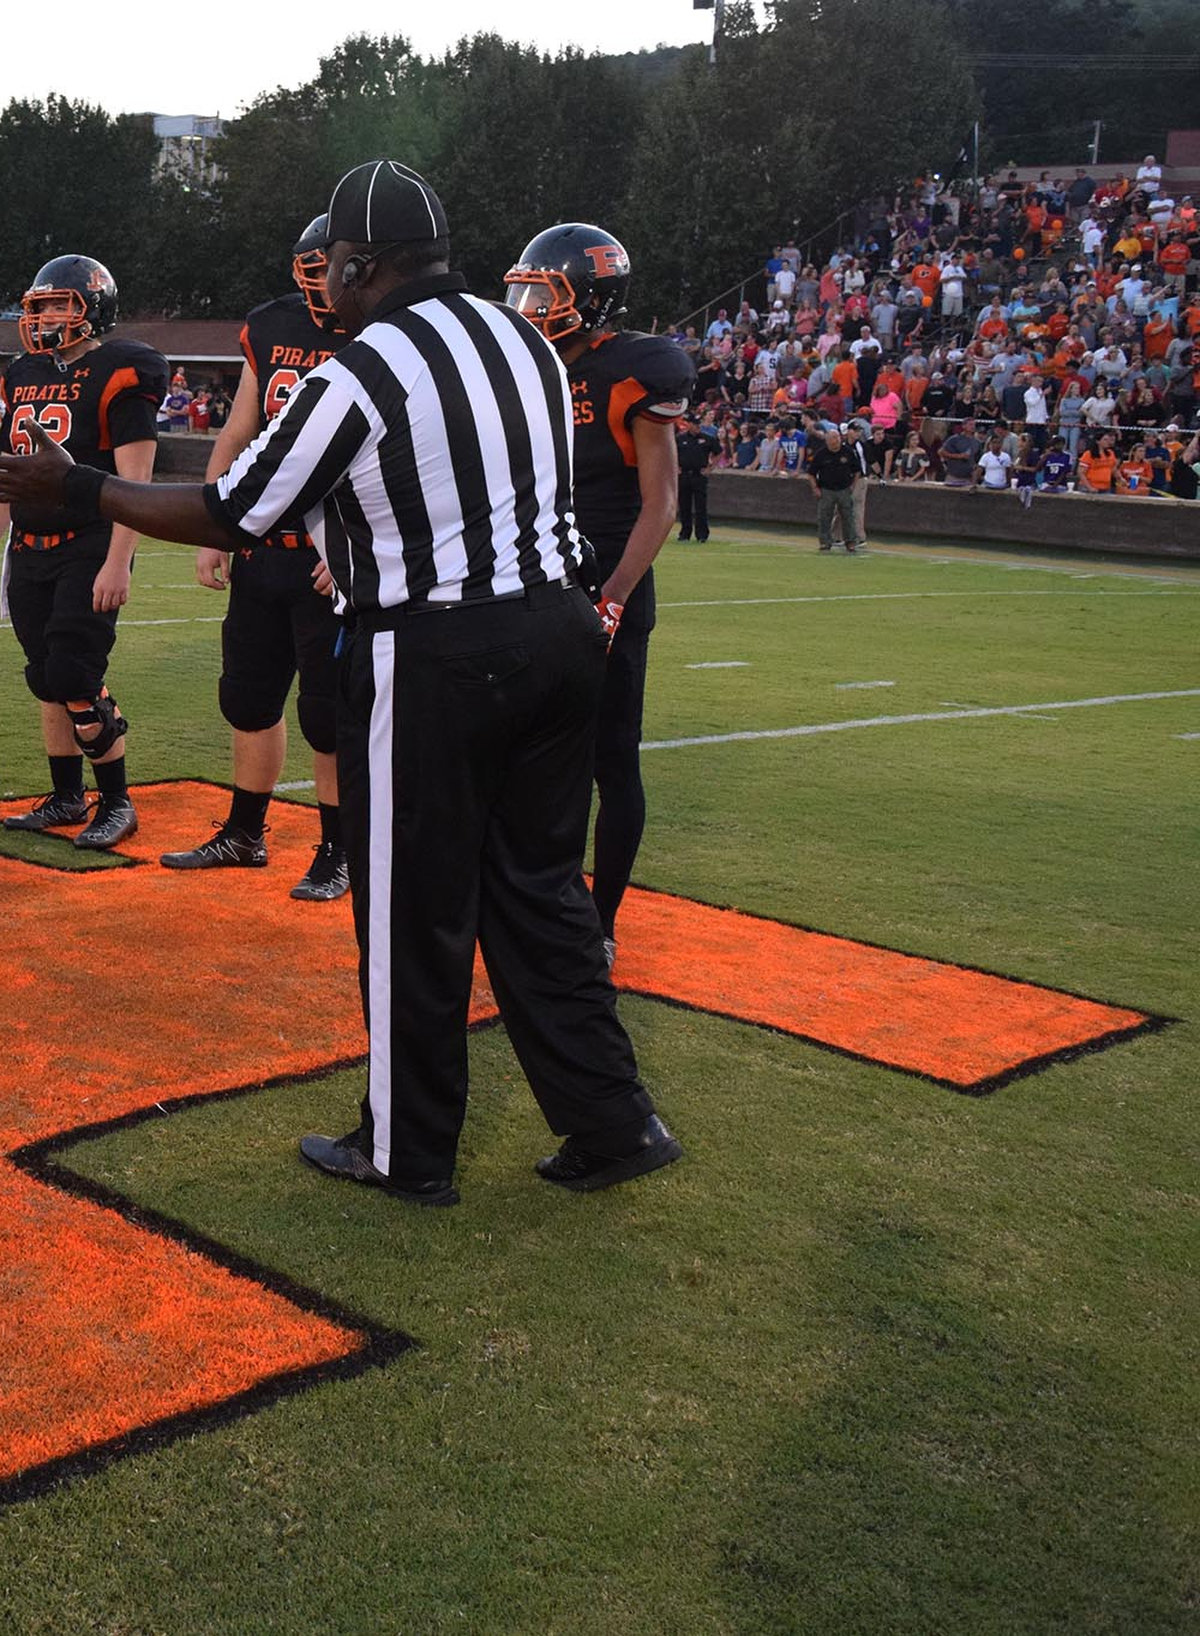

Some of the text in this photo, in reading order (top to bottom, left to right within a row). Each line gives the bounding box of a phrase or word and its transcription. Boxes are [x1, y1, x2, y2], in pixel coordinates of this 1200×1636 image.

[269, 345, 334, 368] PIRAT
[13, 383, 82, 404] PIRATES
[10, 403, 72, 456] 62
